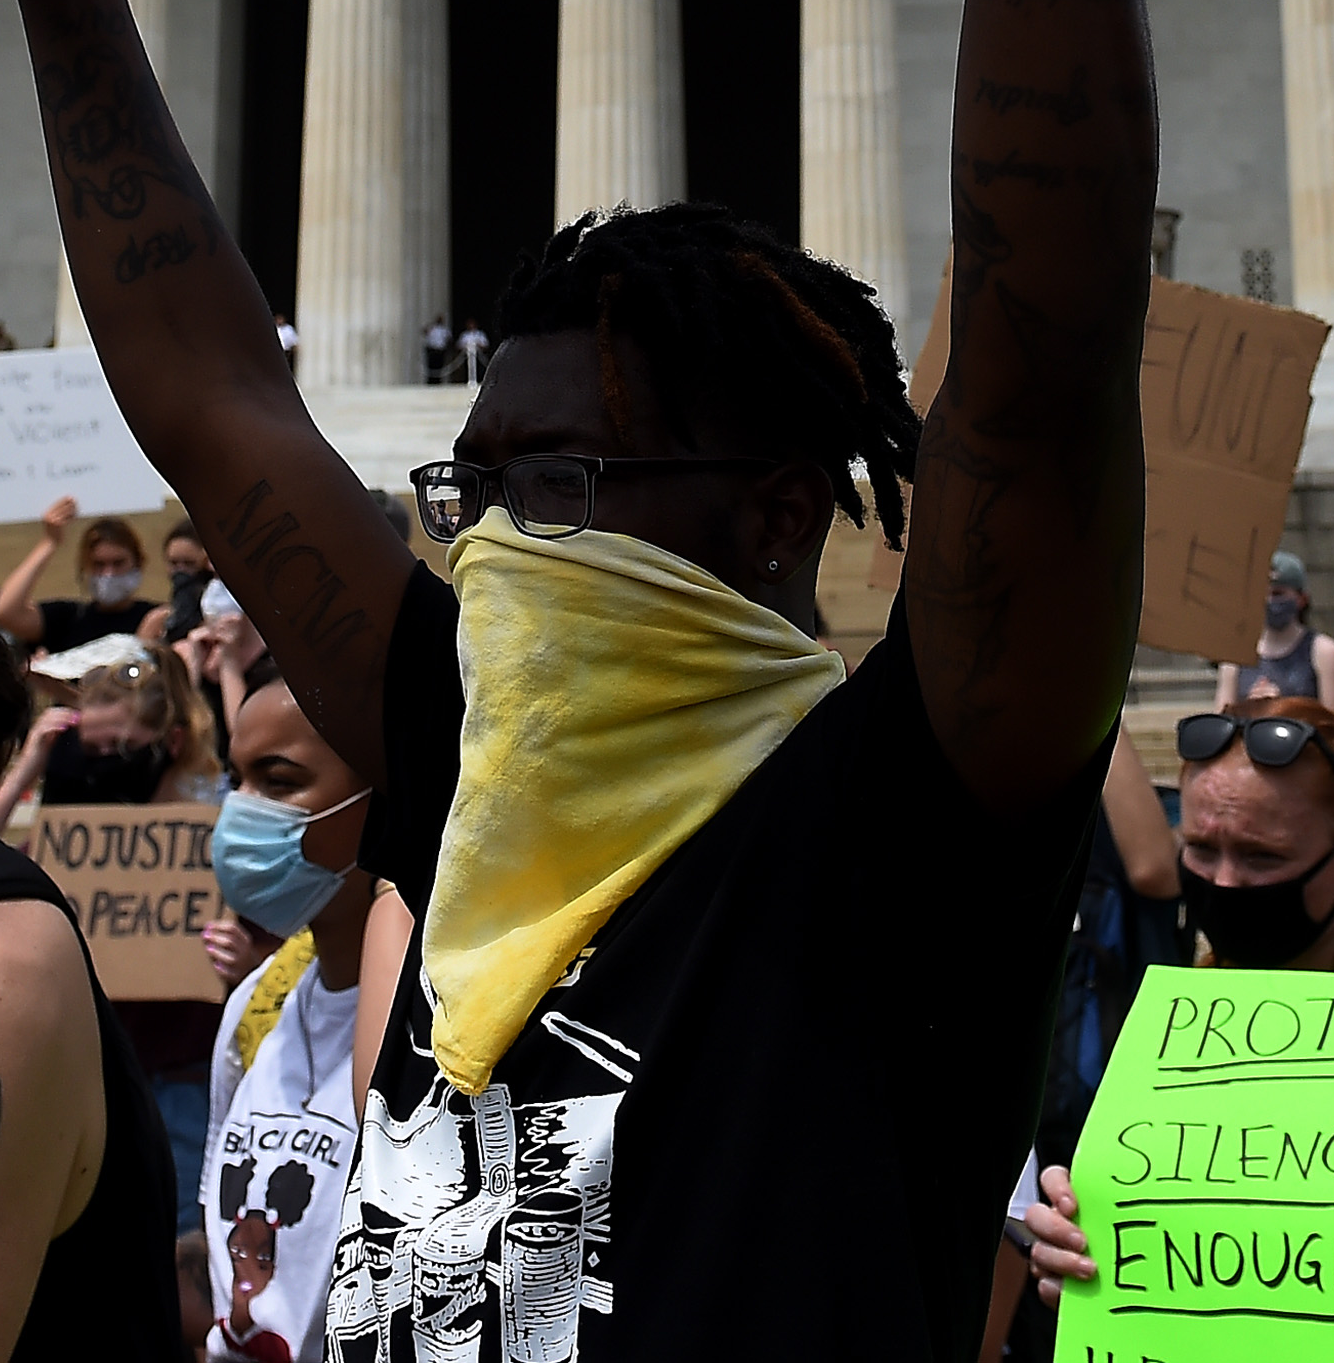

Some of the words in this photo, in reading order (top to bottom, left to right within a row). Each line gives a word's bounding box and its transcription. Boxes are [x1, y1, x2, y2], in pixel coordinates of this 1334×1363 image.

[37, 820, 90, 868] NO
[92, 820, 216, 870] JUSTIC
[290, 1128, 340, 1169] GIRL
